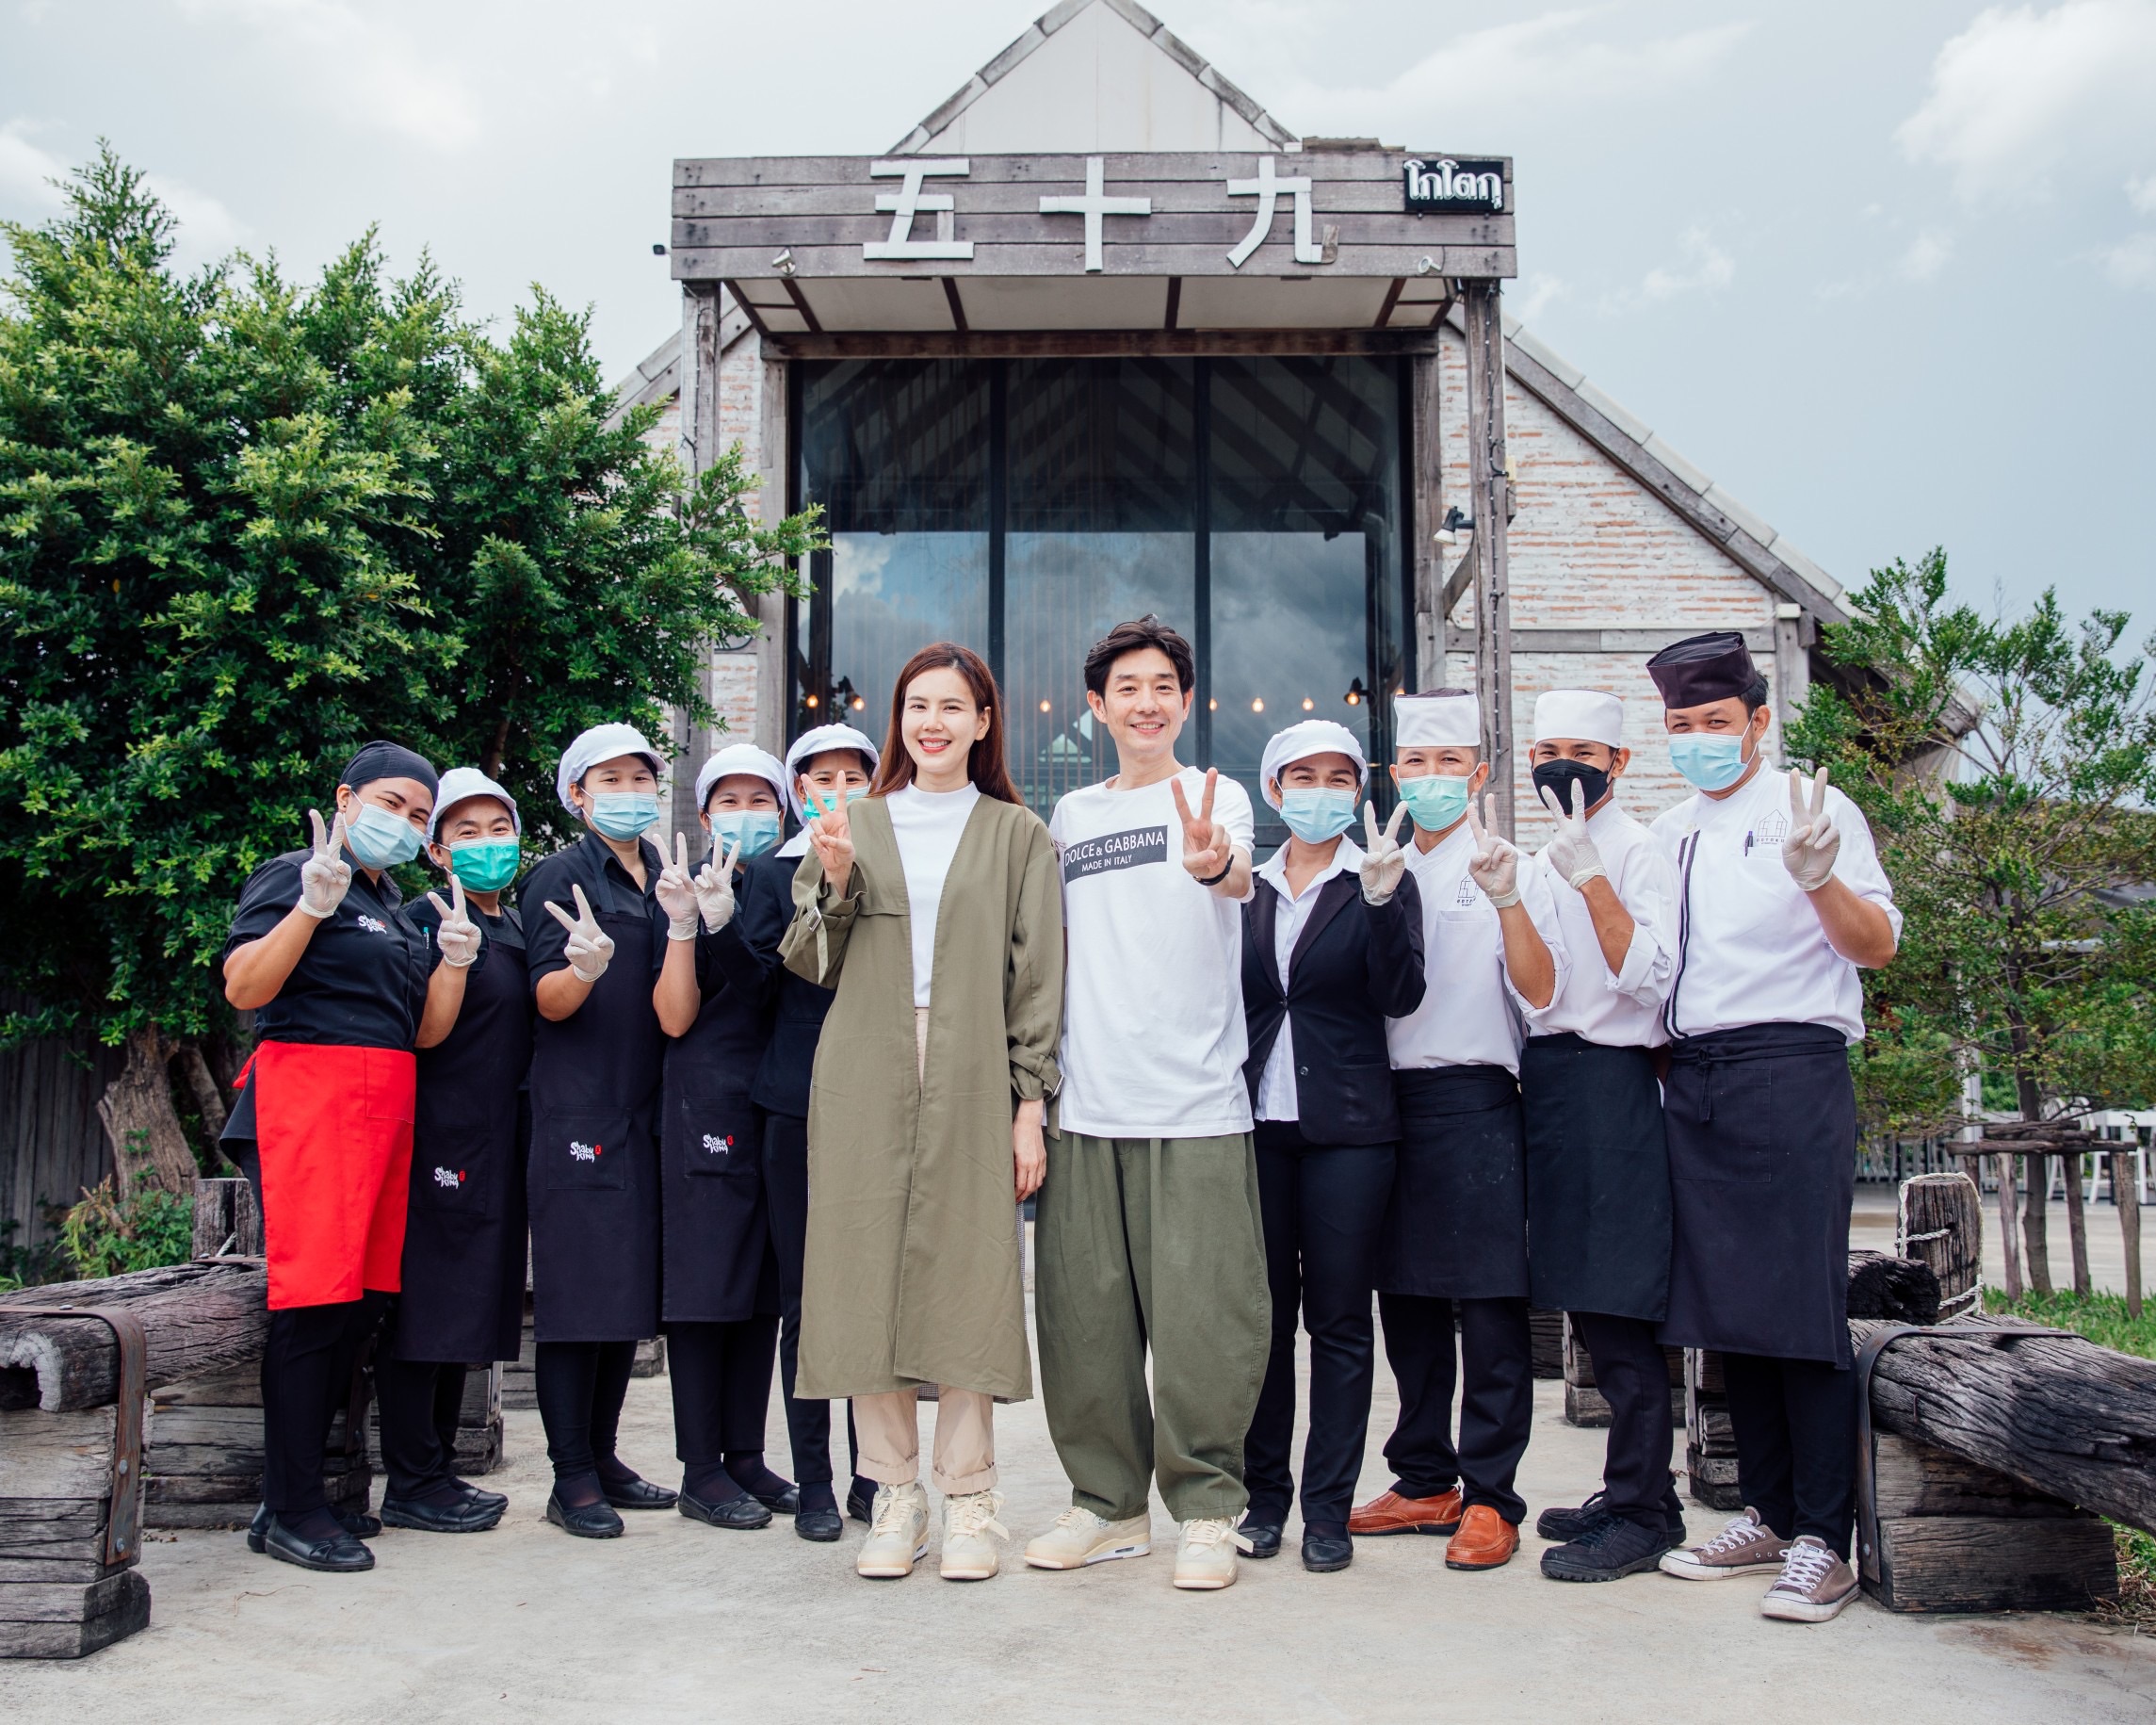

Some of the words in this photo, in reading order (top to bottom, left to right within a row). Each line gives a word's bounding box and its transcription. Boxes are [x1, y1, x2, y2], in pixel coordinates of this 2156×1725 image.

[863, 155, 1339, 272] 五十九
[1064, 843, 1094, 867] DOLCE
[1095, 846, 1103, 856] &
[1104, 831, 1165, 854] GABBANA
[1081, 859, 1102, 872] MADE
[1104, 858, 1111, 867] IN
[1113, 854, 1132, 865] ITALY
